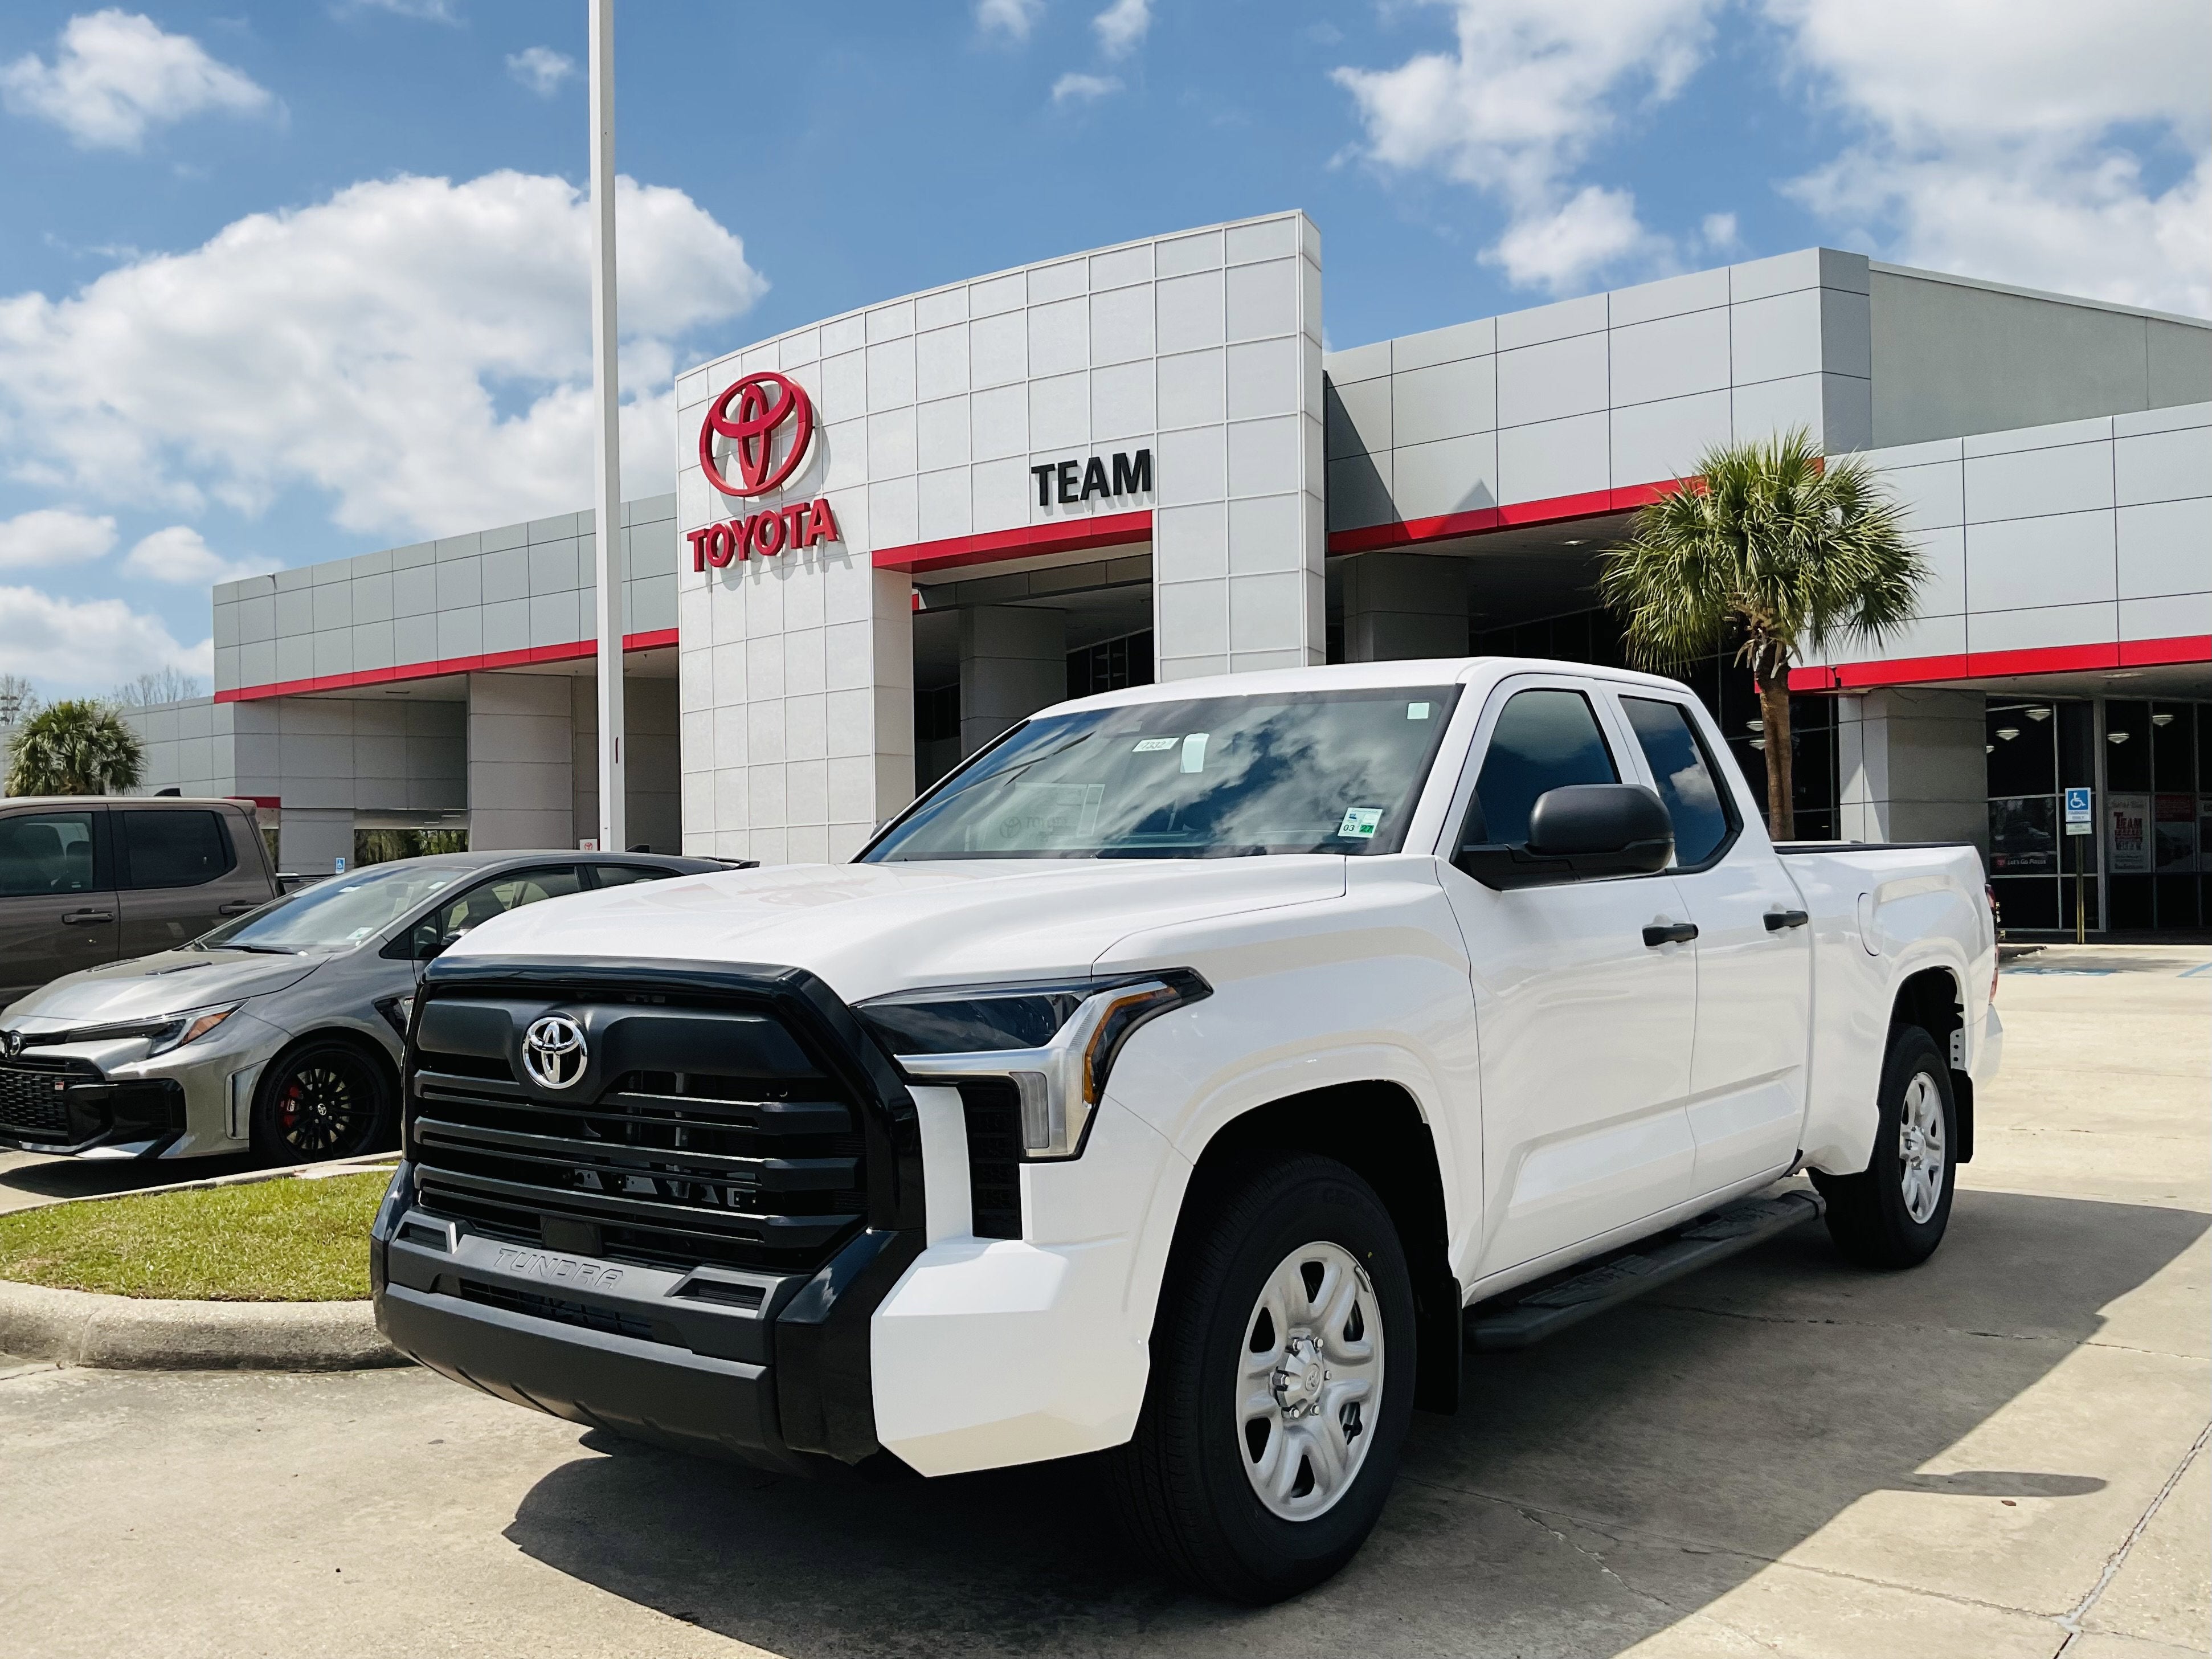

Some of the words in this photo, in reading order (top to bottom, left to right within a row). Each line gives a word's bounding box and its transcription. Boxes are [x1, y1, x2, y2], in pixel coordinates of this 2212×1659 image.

[1031, 448, 1151, 506] TEAM
[686, 498, 840, 573] TOYOTA
[493, 1248, 624, 1290] TUNDRA
